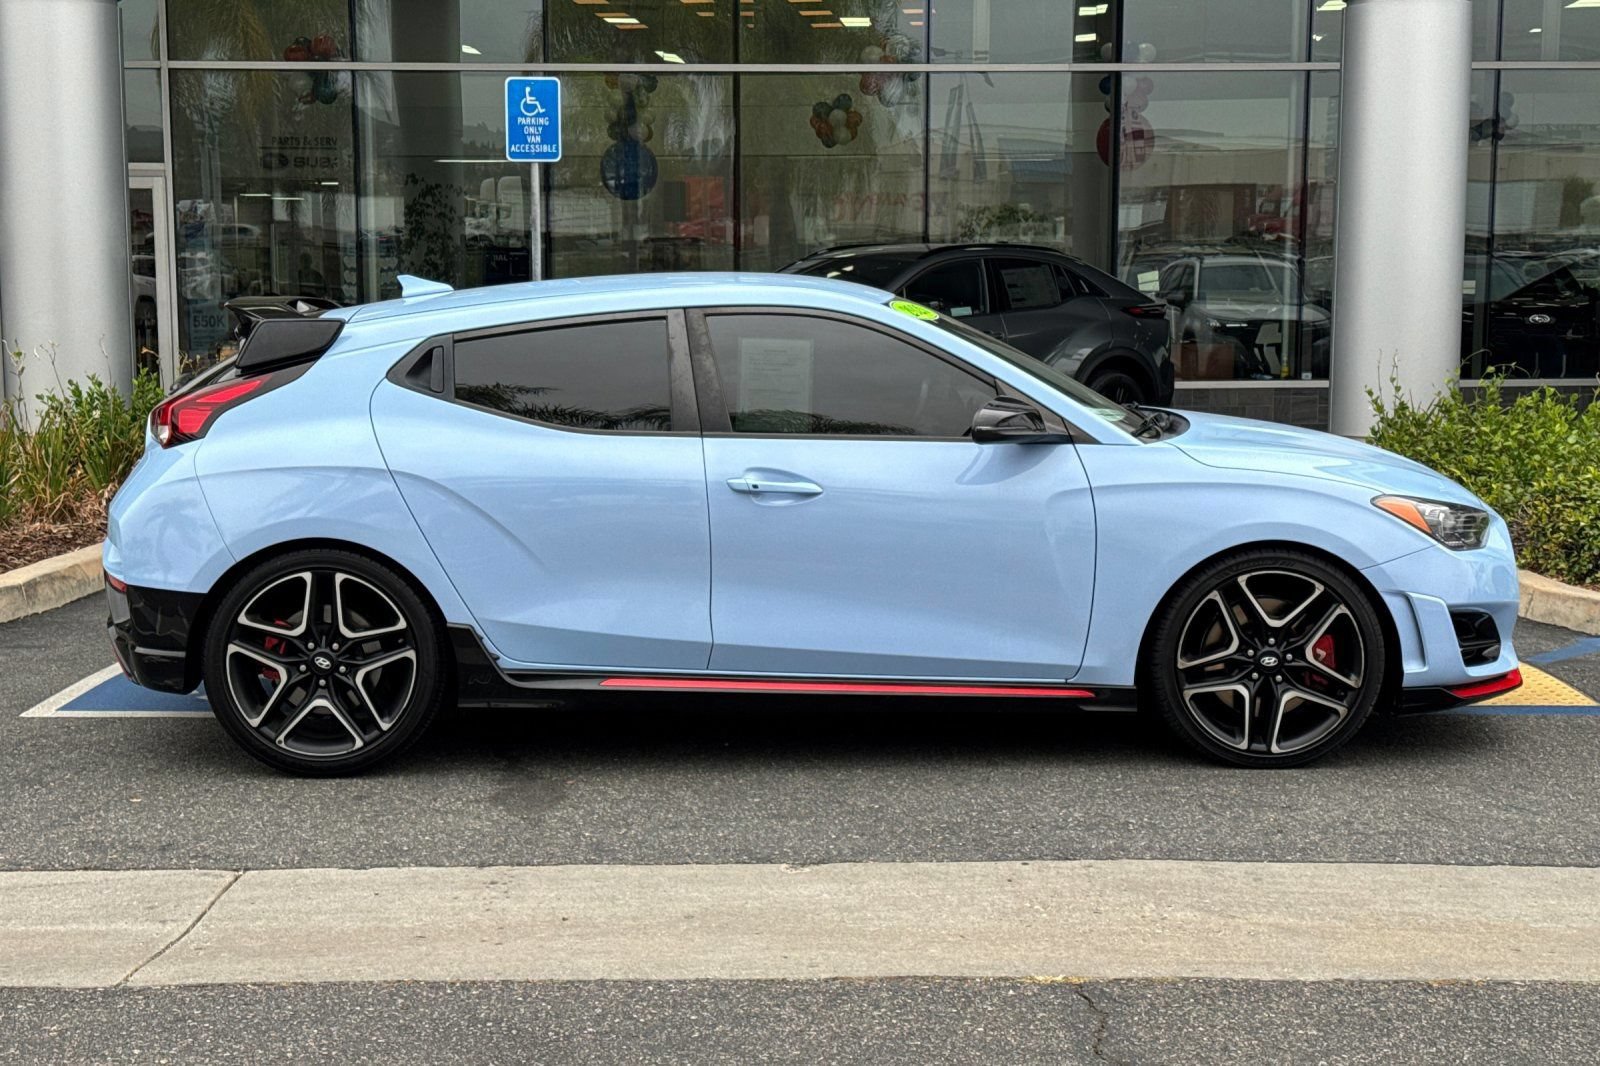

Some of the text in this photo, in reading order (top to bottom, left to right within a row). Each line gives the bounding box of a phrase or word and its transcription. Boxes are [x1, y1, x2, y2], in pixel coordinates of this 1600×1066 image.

[517, 117, 549, 125] PARKING
[523, 126, 542, 134] ONLY
[271, 136, 300, 146] PARTS
[526, 135, 541, 143] VAN
[510, 144, 557, 152] ACCESSIBLE
[193, 315, 225, 328] 550K
